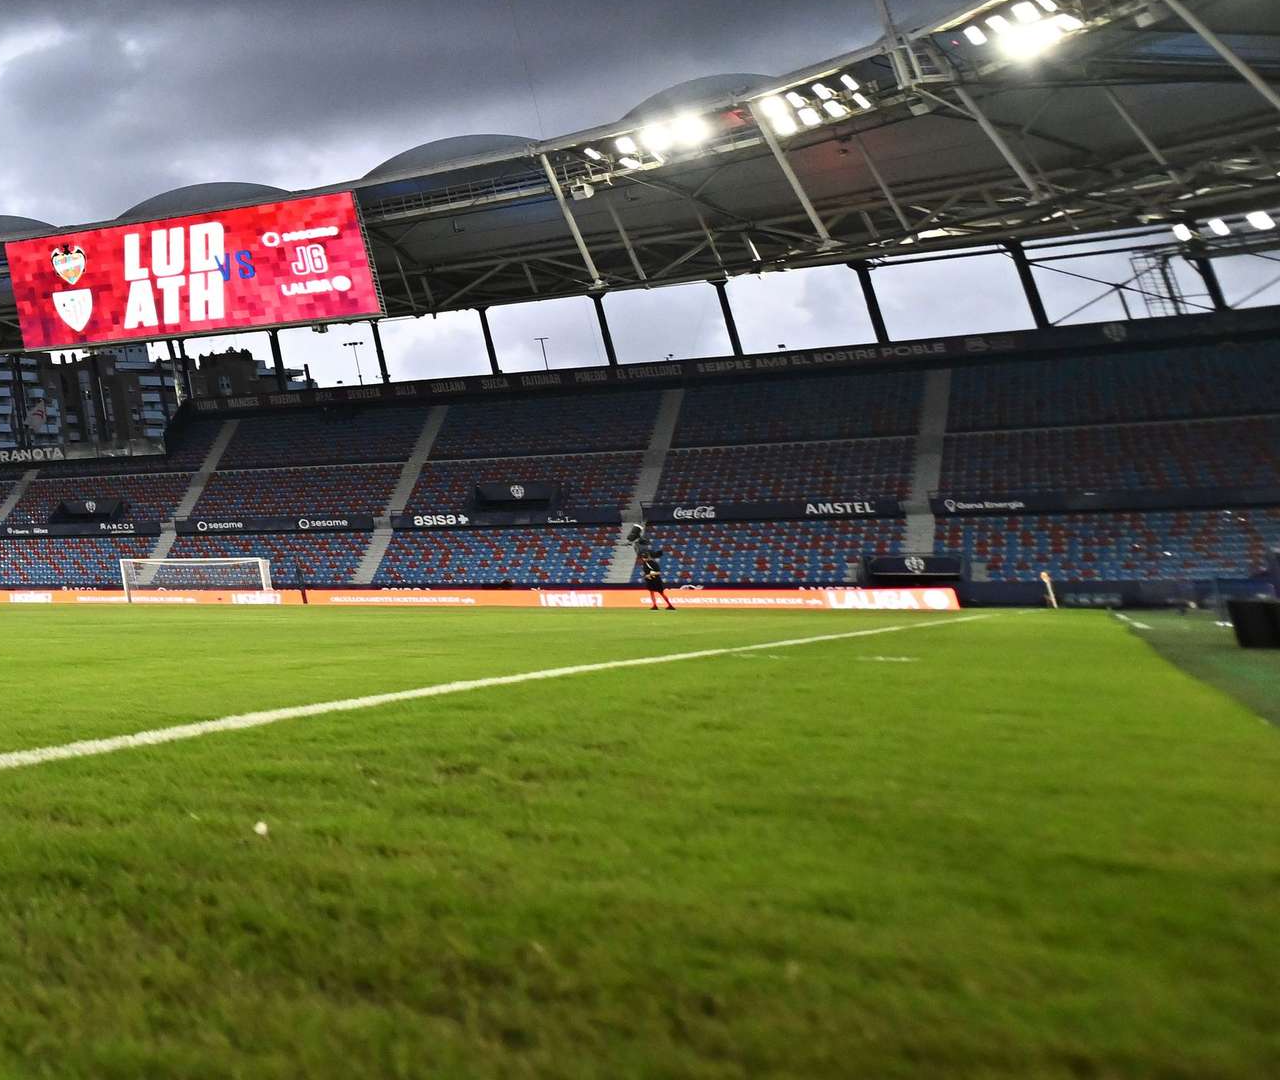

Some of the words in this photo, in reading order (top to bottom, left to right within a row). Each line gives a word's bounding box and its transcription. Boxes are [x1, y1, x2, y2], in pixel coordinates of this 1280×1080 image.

[123, 221, 225, 281] LUD
[214, 249, 256, 281] VS
[123, 270, 225, 329] ATH
[790, 355, 812, 367] EL
[805, 501, 875, 515] AMSTEL
[208, 521, 243, 530] sesame
[311, 519, 348, 528] sesame
[414, 514, 456, 526] asisa
